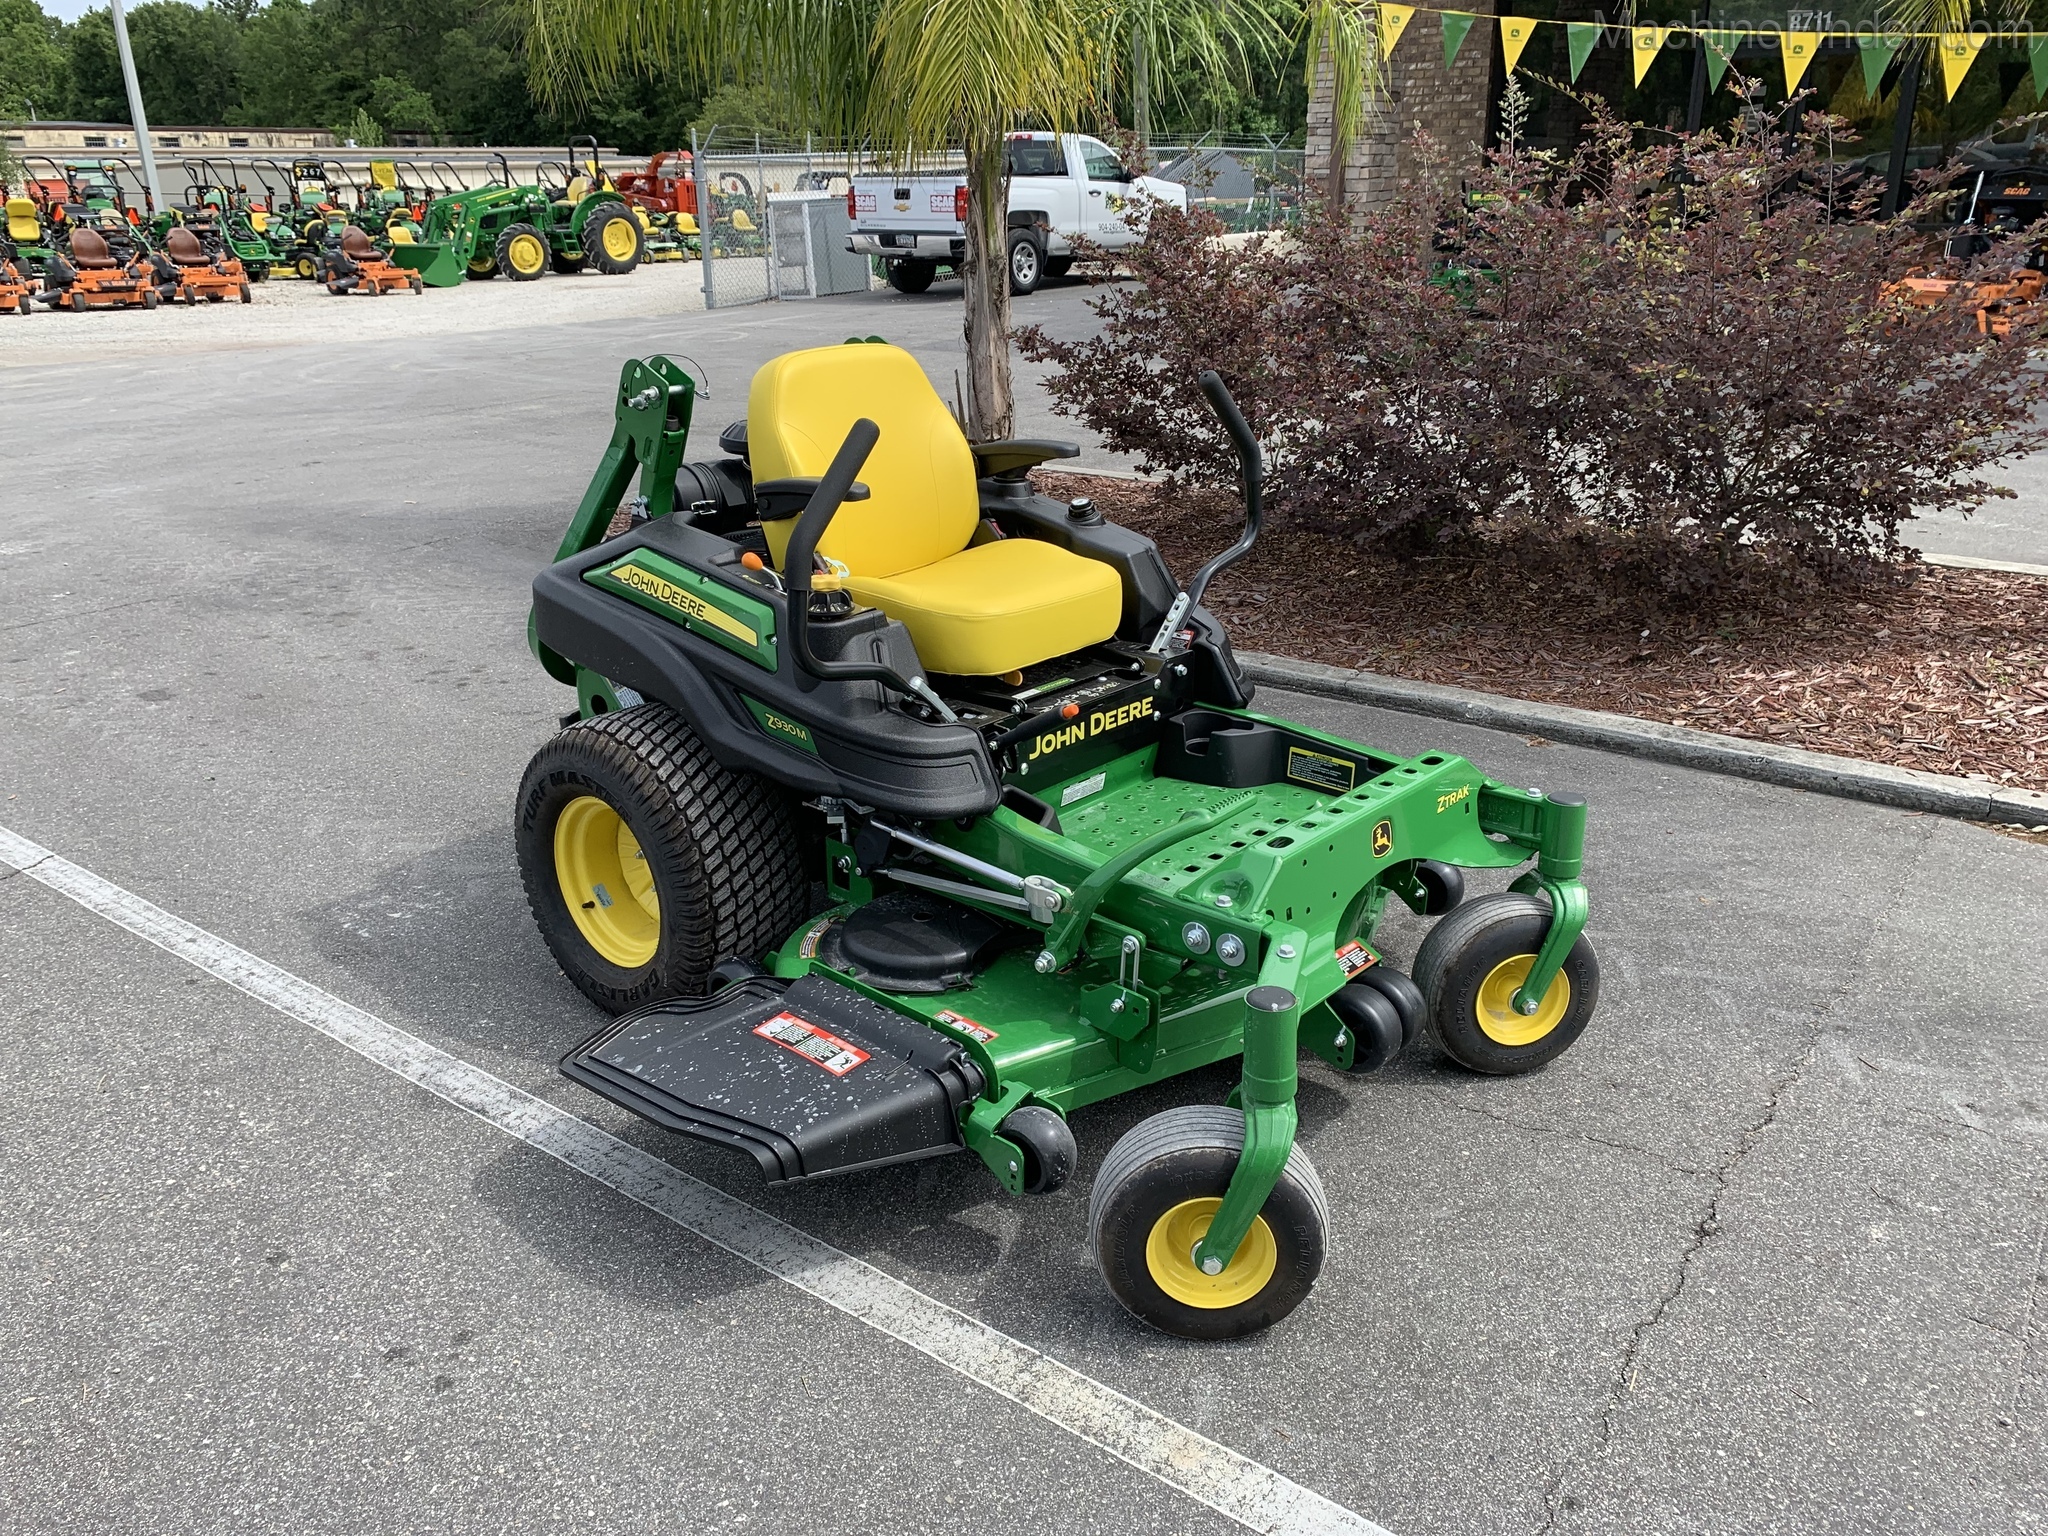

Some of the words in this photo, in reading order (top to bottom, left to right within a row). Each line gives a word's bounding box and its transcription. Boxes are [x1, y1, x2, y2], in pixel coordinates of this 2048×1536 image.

[1789, 11, 1833, 31] 8711
[854, 195, 876, 207] SCAG
[930, 195, 955, 207] SCAG
[2003, 187, 2031, 196] SCAG
[624, 568, 659, 597] JOHN
[661, 584, 706, 618] DEERE
[765, 712, 808, 741] Z930M
[1029, 721, 1085, 760] JOHN
[1090, 696, 1154, 736] DEERE
[522, 778, 547, 832] TURF
[549, 769, 633, 824] MASTER
[1436, 783, 1470, 814] ZTRAK
[574, 961, 661, 1005] CARLISLE
[1456, 956, 1488, 1035] RELIANCE
[1567, 959, 1590, 1034] CARLISLE
[1113, 1203, 1143, 1292] CARLISLE
[1271, 1225, 1313, 1310] RELIANCE
